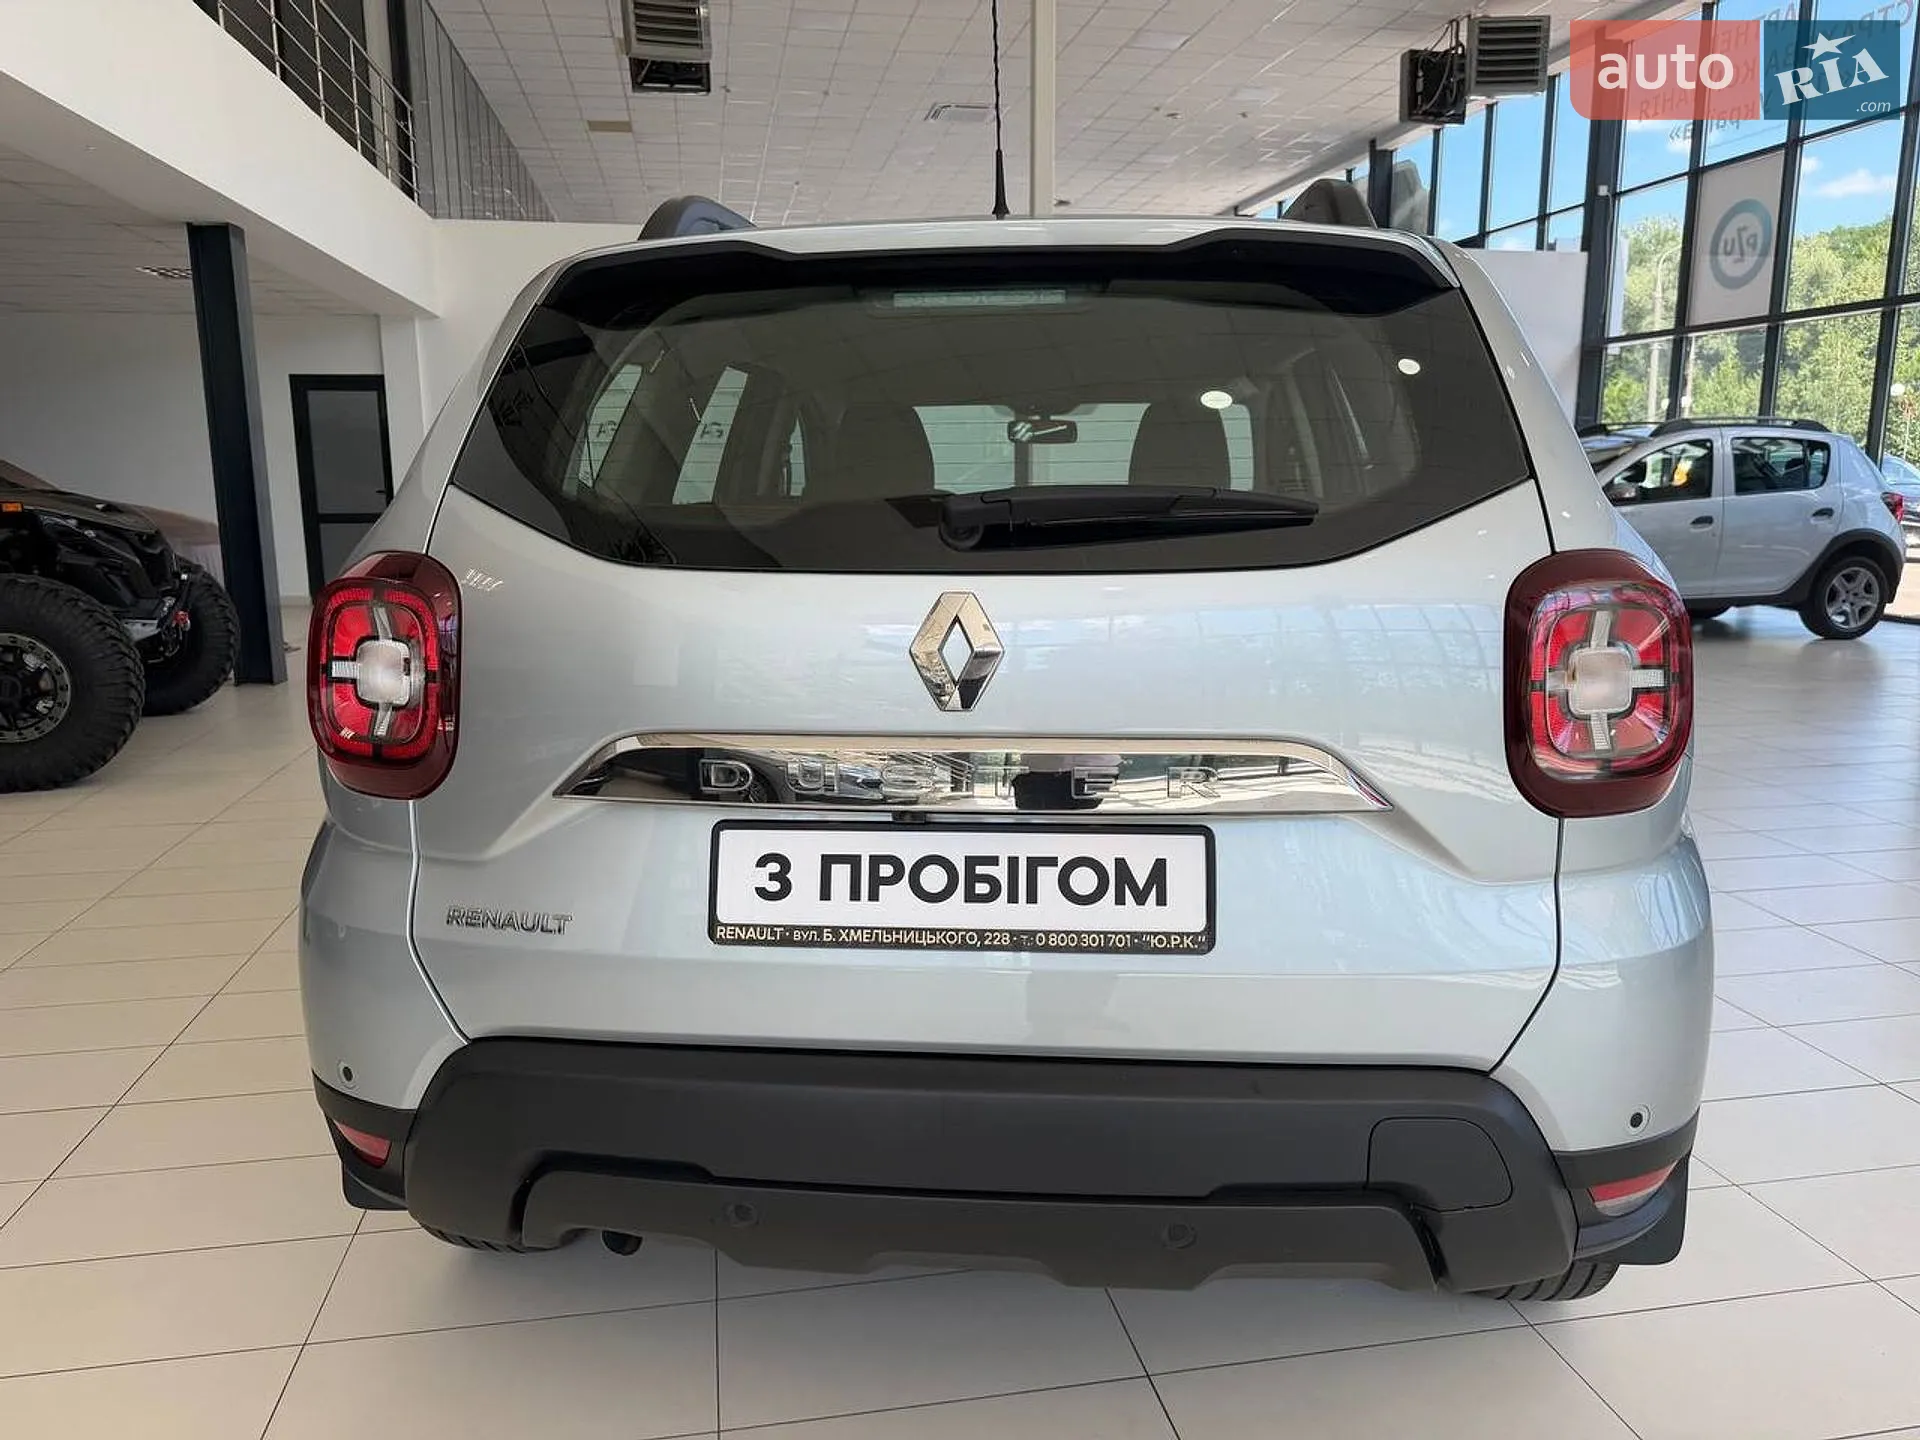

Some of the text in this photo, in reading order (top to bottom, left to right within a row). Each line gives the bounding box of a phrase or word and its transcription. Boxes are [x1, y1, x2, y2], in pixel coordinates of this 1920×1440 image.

[820, 854, 1168, 907] ПРОБІГОМ
[446, 905, 573, 936] RENAULT
[716, 925, 784, 941] RENAULT
[793, 929, 820, 942] вул.
[823, 928, 836, 942] Б.
[838, 928, 982, 947] ХМЕЛЬНИЦЬКОГО,
[984, 932, 1011, 946] 228
